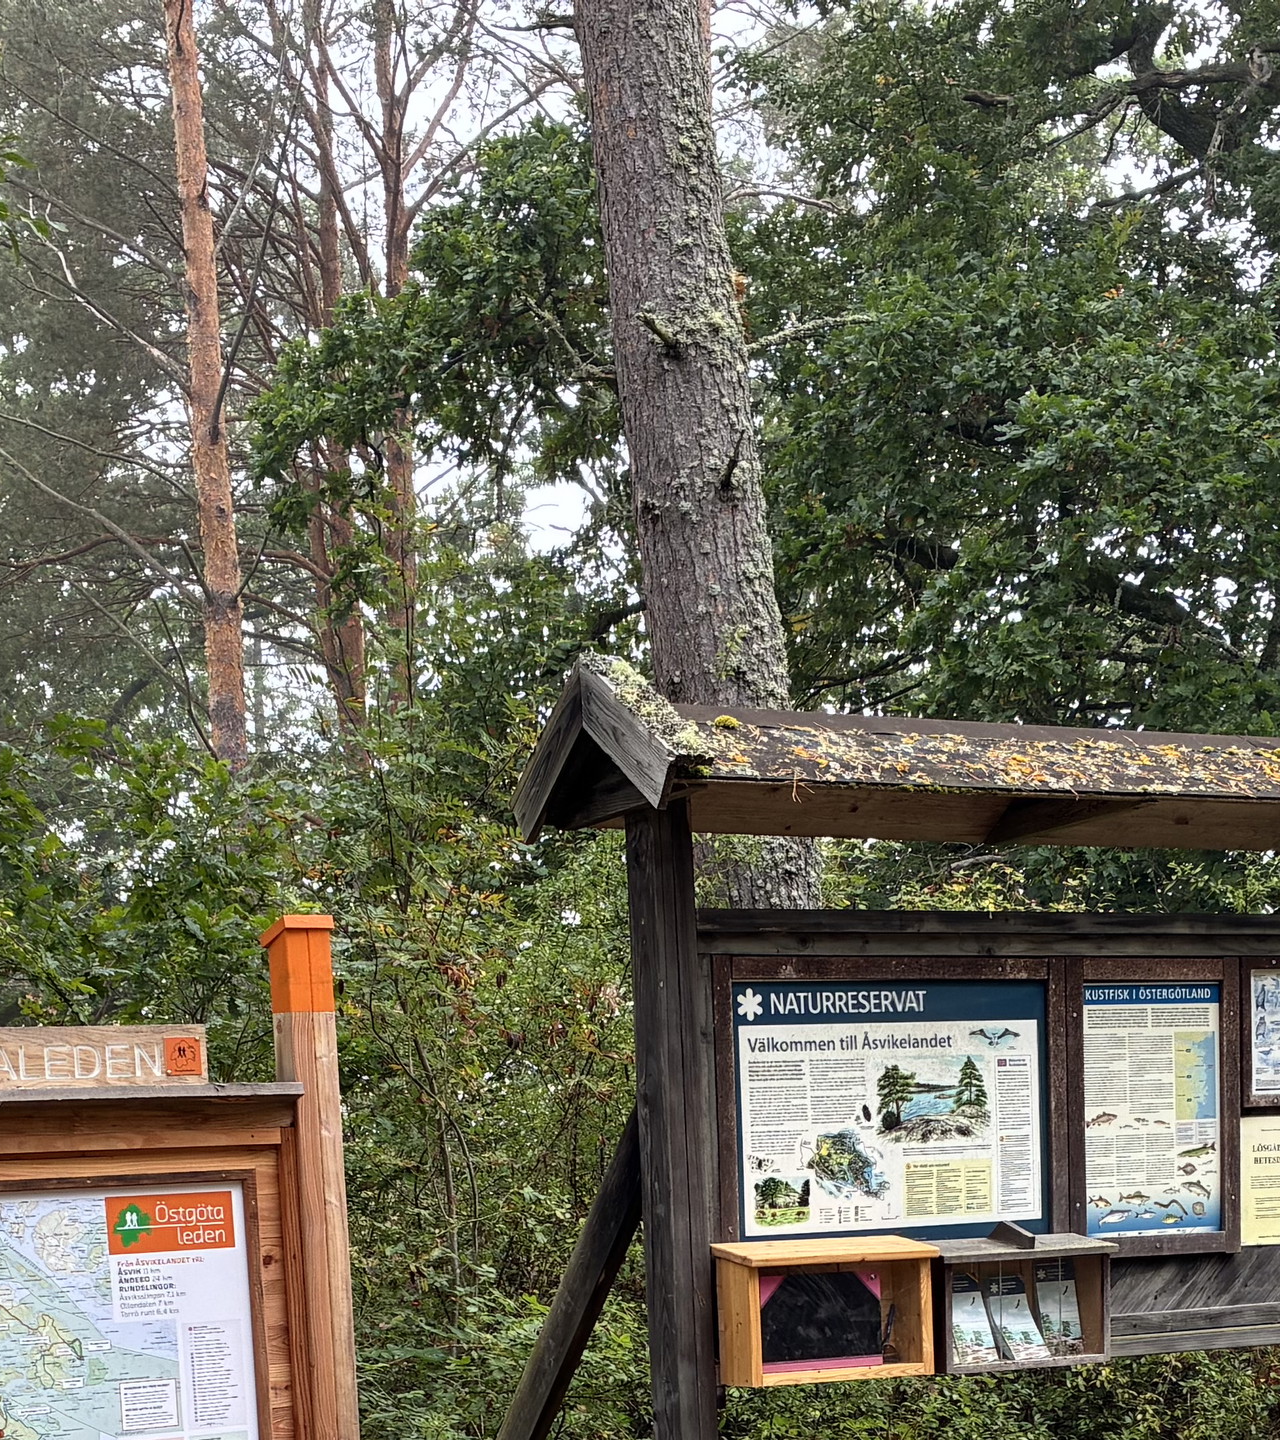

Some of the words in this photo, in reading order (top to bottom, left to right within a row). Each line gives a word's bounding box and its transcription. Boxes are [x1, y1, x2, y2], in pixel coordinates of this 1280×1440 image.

[770, 990, 927, 1015] NATURRESERVAT
[1085, 988, 1130, 1001] KUSTFISK
[1132, 989, 1136, 1000] I
[1138, 987, 1211, 1000] ÖSTERGÖTLAND
[747, 1035, 835, 1053] Välkommen
[839, 1034, 858, 1051] till
[861, 1031, 952, 1050] Åsvikelandet
[155, 1201, 224, 1226] Östgöta
[177, 1225, 226, 1245] leden
